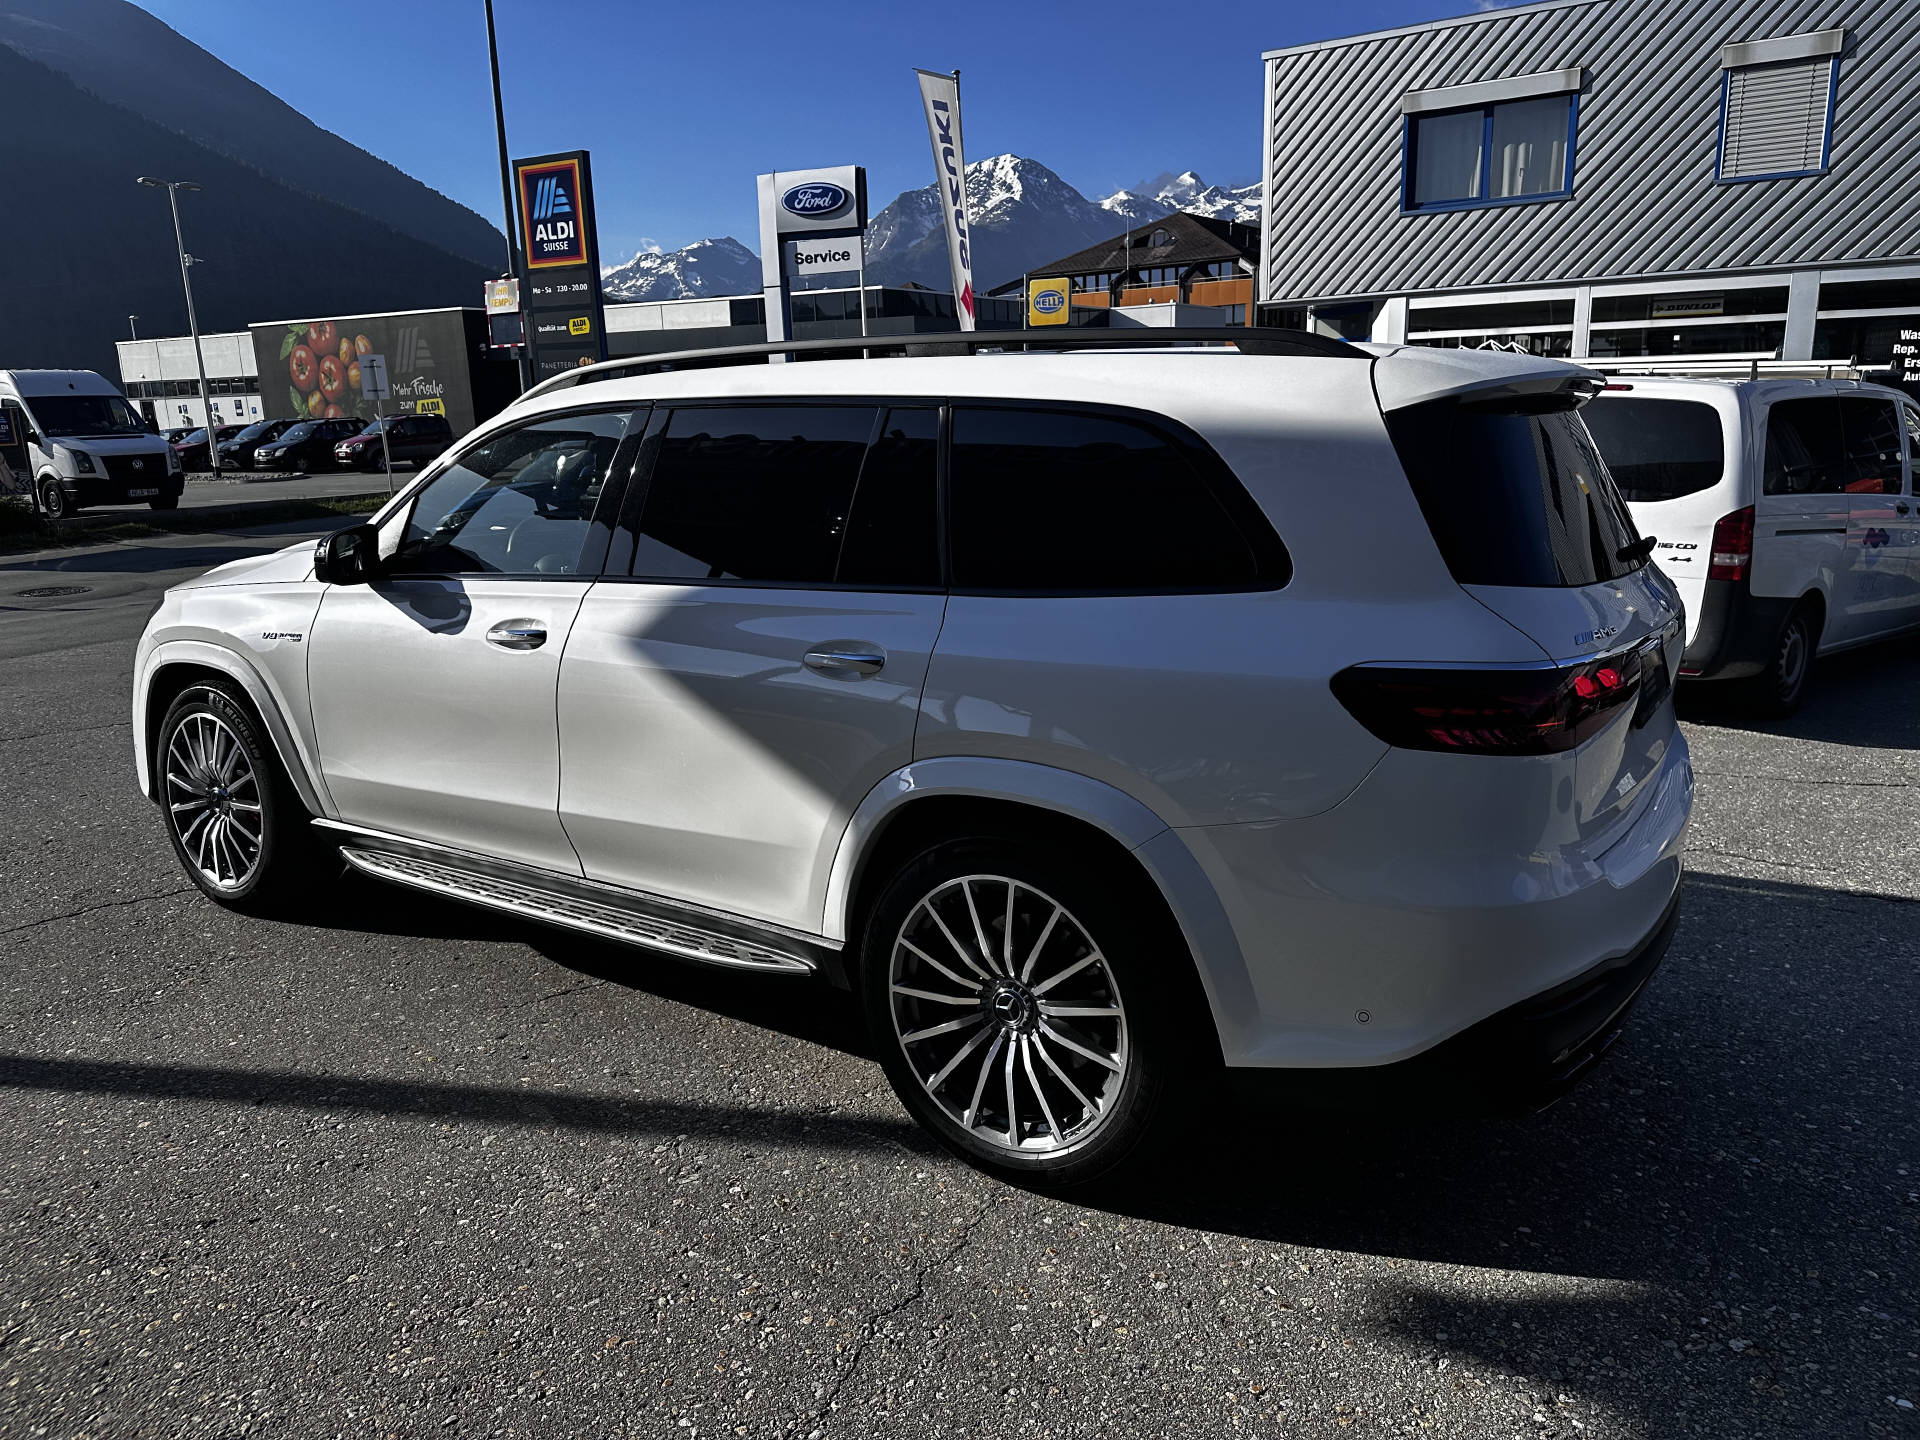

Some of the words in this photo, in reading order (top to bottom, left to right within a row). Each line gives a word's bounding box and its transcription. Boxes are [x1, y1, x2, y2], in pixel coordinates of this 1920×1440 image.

[931, 99, 970, 270] SUZUKI
[795, 188, 832, 209] Ford
[535, 220, 575, 241] ALDI
[543, 241, 569, 252] SUISSE
[794, 250, 851, 264] Service
[1034, 296, 1065, 307] HELLA
[1665, 302, 1722, 311] DUNLOP
[572, 319, 586, 328] ALDI
[1893, 344, 1919, 356] Rep.
[541, 361, 578, 369] PANETTERIA
[392, 383, 412, 396] Mehr
[410, 376, 443, 397] Frische
[400, 401, 415, 410] zum
[420, 400, 441, 412] ALDI
[224, 706, 261, 758] MICHELIN
